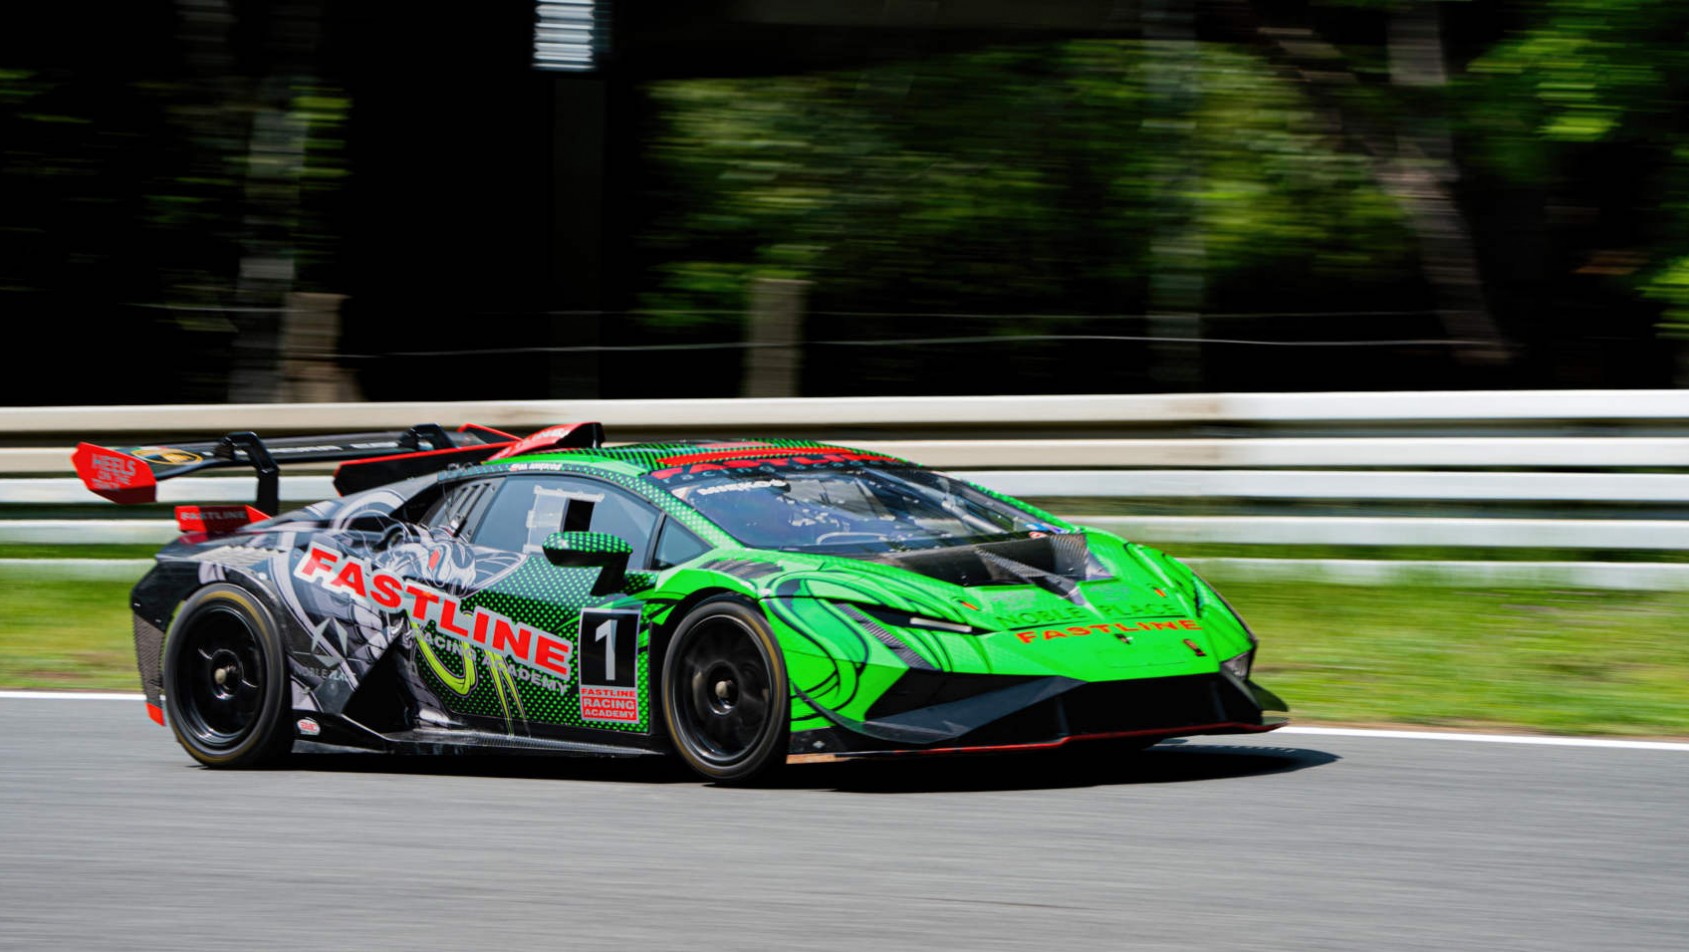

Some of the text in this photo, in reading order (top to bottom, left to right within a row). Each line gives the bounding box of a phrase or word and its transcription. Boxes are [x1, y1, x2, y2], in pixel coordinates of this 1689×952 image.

[91, 453, 136, 477] HEELS
[296, 543, 572, 678] FASTLINE
[995, 603, 1181, 627] NOBLE PLACE
[1015, 620, 1203, 643] FASTLINE
[413, 627, 569, 695] RACING ACADEMY
[595, 620, 618, 680] 1
[581, 688, 636, 697] FASTLINE
[583, 698, 635, 709] RACING
[585, 709, 635, 718] ACADEMY
